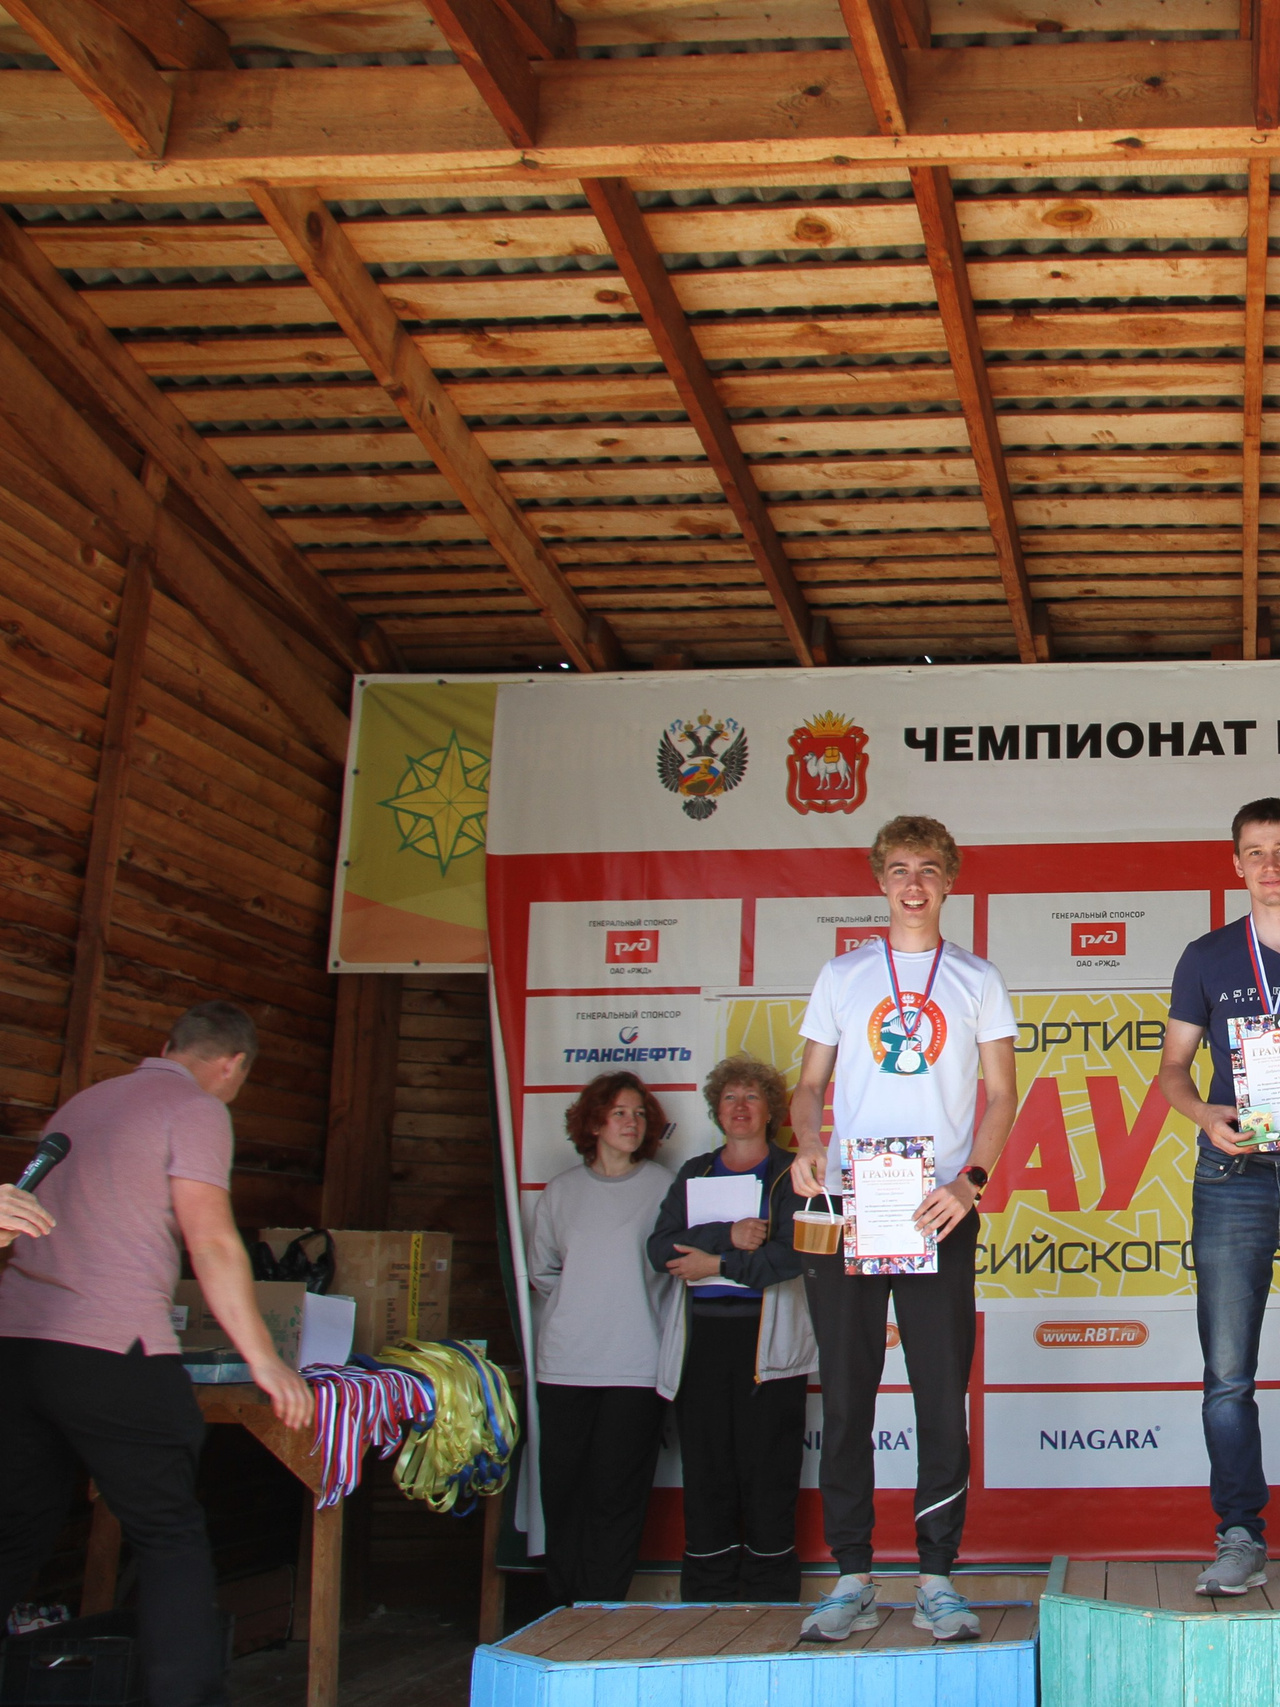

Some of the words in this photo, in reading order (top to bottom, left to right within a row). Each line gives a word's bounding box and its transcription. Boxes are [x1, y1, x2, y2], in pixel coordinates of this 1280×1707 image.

[903, 720, 1257, 763] ЧЕМПИОНАТ
[816, 914, 872, 924] ГЕНЕРАЛЬНЫЙ
[1051, 910, 1108, 920] ГЕНЕРАЛЬНЫЙ
[1109, 910, 1146, 919] СПОНСОР
[588, 918, 642, 928] ГЕНЕРАЛЬНЫЙ
[643, 918, 678, 927] СПОНСОР
[609, 967, 625, 975] ОАО
[575, 1009, 639, 1020] ГЕНЕРАЛЬНЫЙ
[640, 1010, 682, 1020] СПОНСОР
[563, 1047, 693, 1063] ТРАНСНЕФТЬ
[862, 1168, 915, 1179] ГРАМОТА
[1043, 1327, 1136, 1343] www.RBT.ru
[1040, 1428, 1159, 1450] NIAGARA
